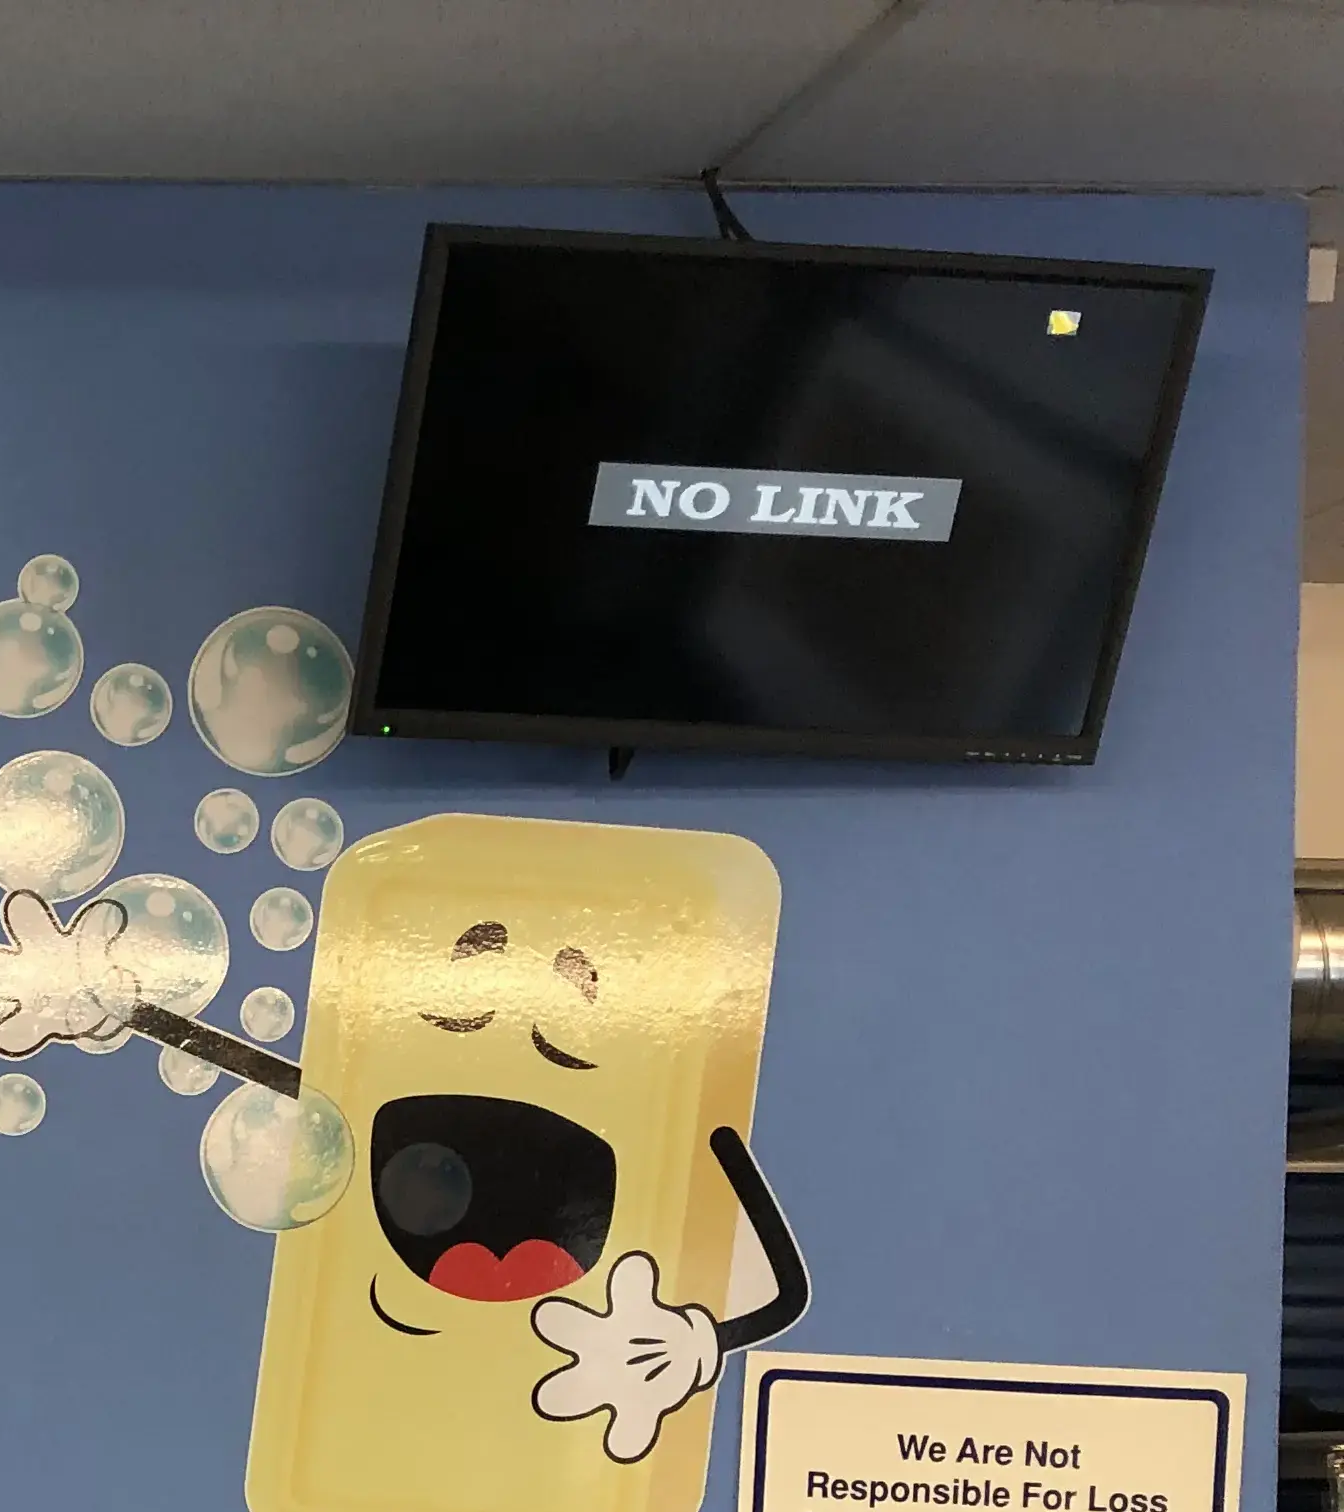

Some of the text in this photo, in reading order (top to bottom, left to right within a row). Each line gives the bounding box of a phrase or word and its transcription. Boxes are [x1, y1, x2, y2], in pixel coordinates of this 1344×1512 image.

[626, 478, 924, 530] NO LINK
[898, 1434, 1081, 1469] We Are Not
[806, 1471, 1010, 1507] Responsible
[1022, 1483, 1076, 1511] For
